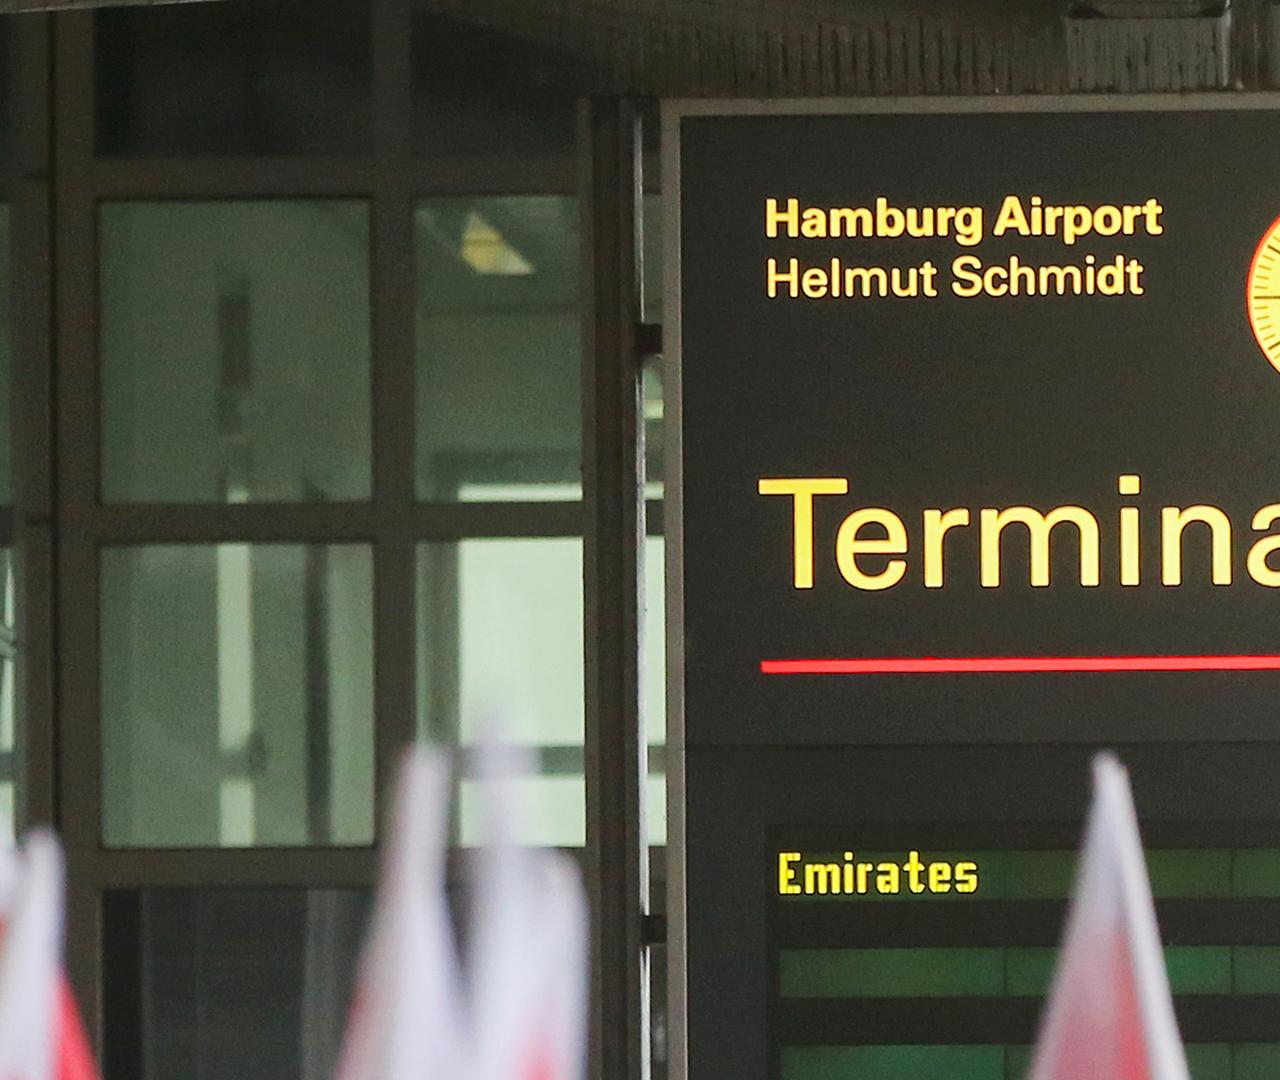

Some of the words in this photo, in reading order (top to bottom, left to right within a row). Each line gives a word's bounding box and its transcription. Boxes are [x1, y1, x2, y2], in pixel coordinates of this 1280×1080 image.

[765, 197, 983, 246] Hamburg
[993, 196, 1163, 245] Airport
[766, 257, 938, 298] Helmut
[951, 254, 1144, 297] Schmidt
[778, 850, 978, 895] Emirates
